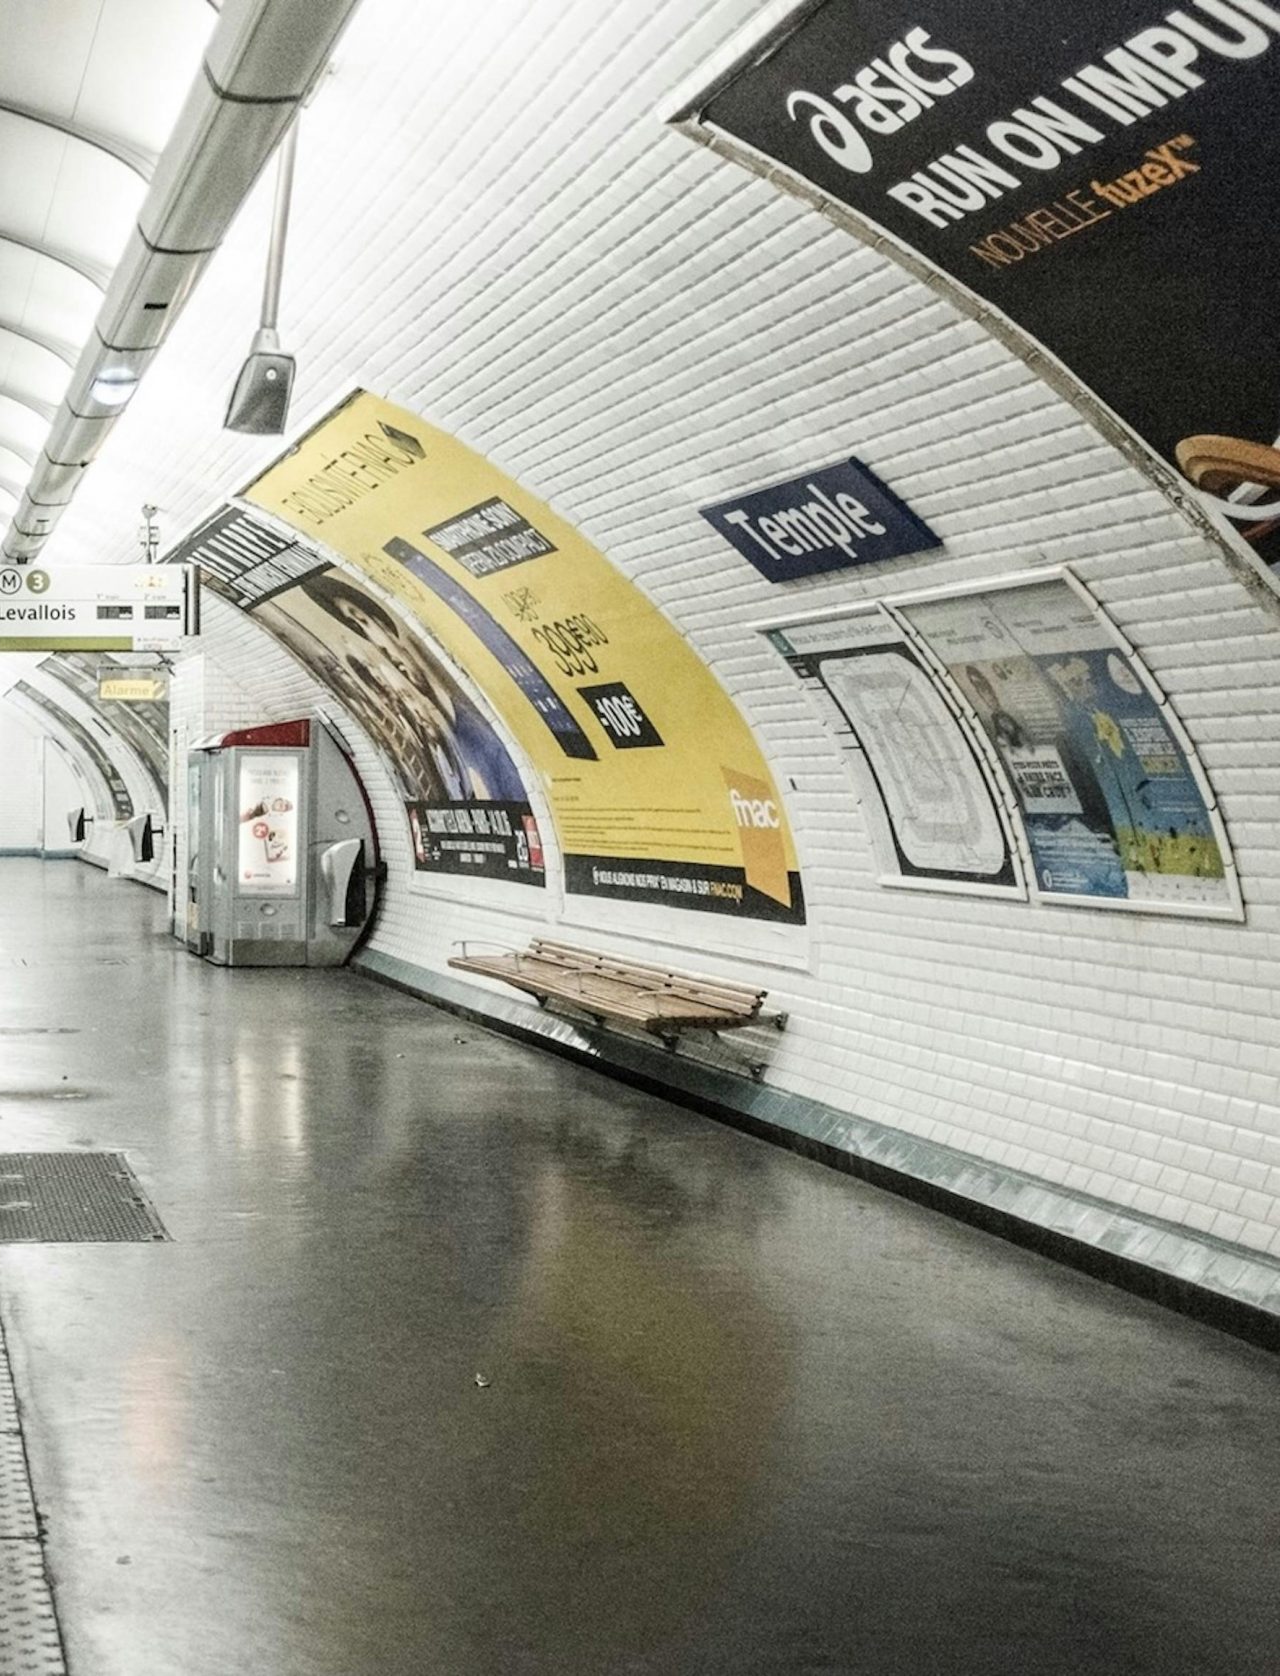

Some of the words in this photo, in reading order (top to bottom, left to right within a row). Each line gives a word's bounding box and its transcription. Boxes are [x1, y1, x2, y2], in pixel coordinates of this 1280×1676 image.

[832, 25, 975, 135] asics
[886, 144, 1022, 230] RUN
[986, 95, 1106, 171] ON
[968, 189, 1113, 270] NOUVELLE
[723, 483, 887, 561] Temple
[104, 683, 150, 697] Alarme
[730, 788, 780, 829] fnac
